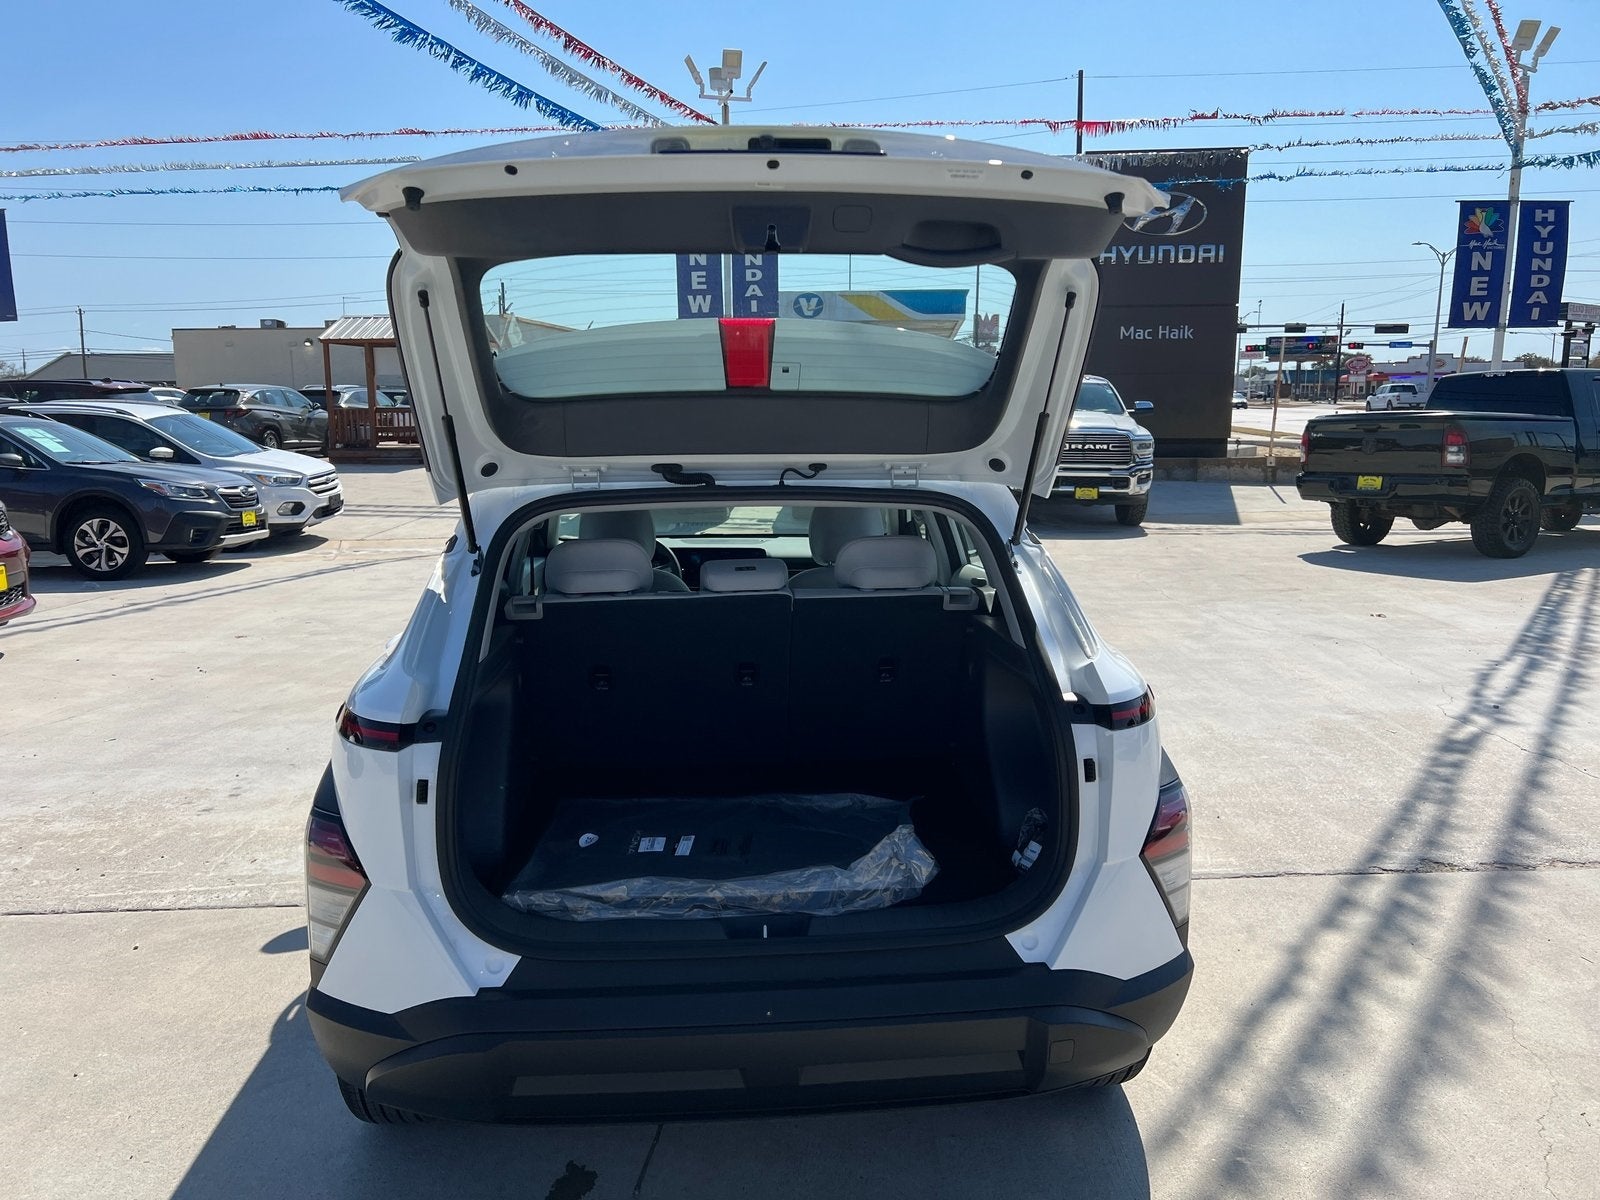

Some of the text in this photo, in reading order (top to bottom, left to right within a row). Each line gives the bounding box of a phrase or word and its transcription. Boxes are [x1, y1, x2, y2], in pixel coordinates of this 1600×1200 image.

[687, 253, 712, 314] NEW
[1099, 244, 1225, 265] HYUNDAI
[1526, 209, 1556, 320] HYUNDAI
[1462, 251, 1493, 321] NEW
[1120, 324, 1194, 340] Mac Haik
